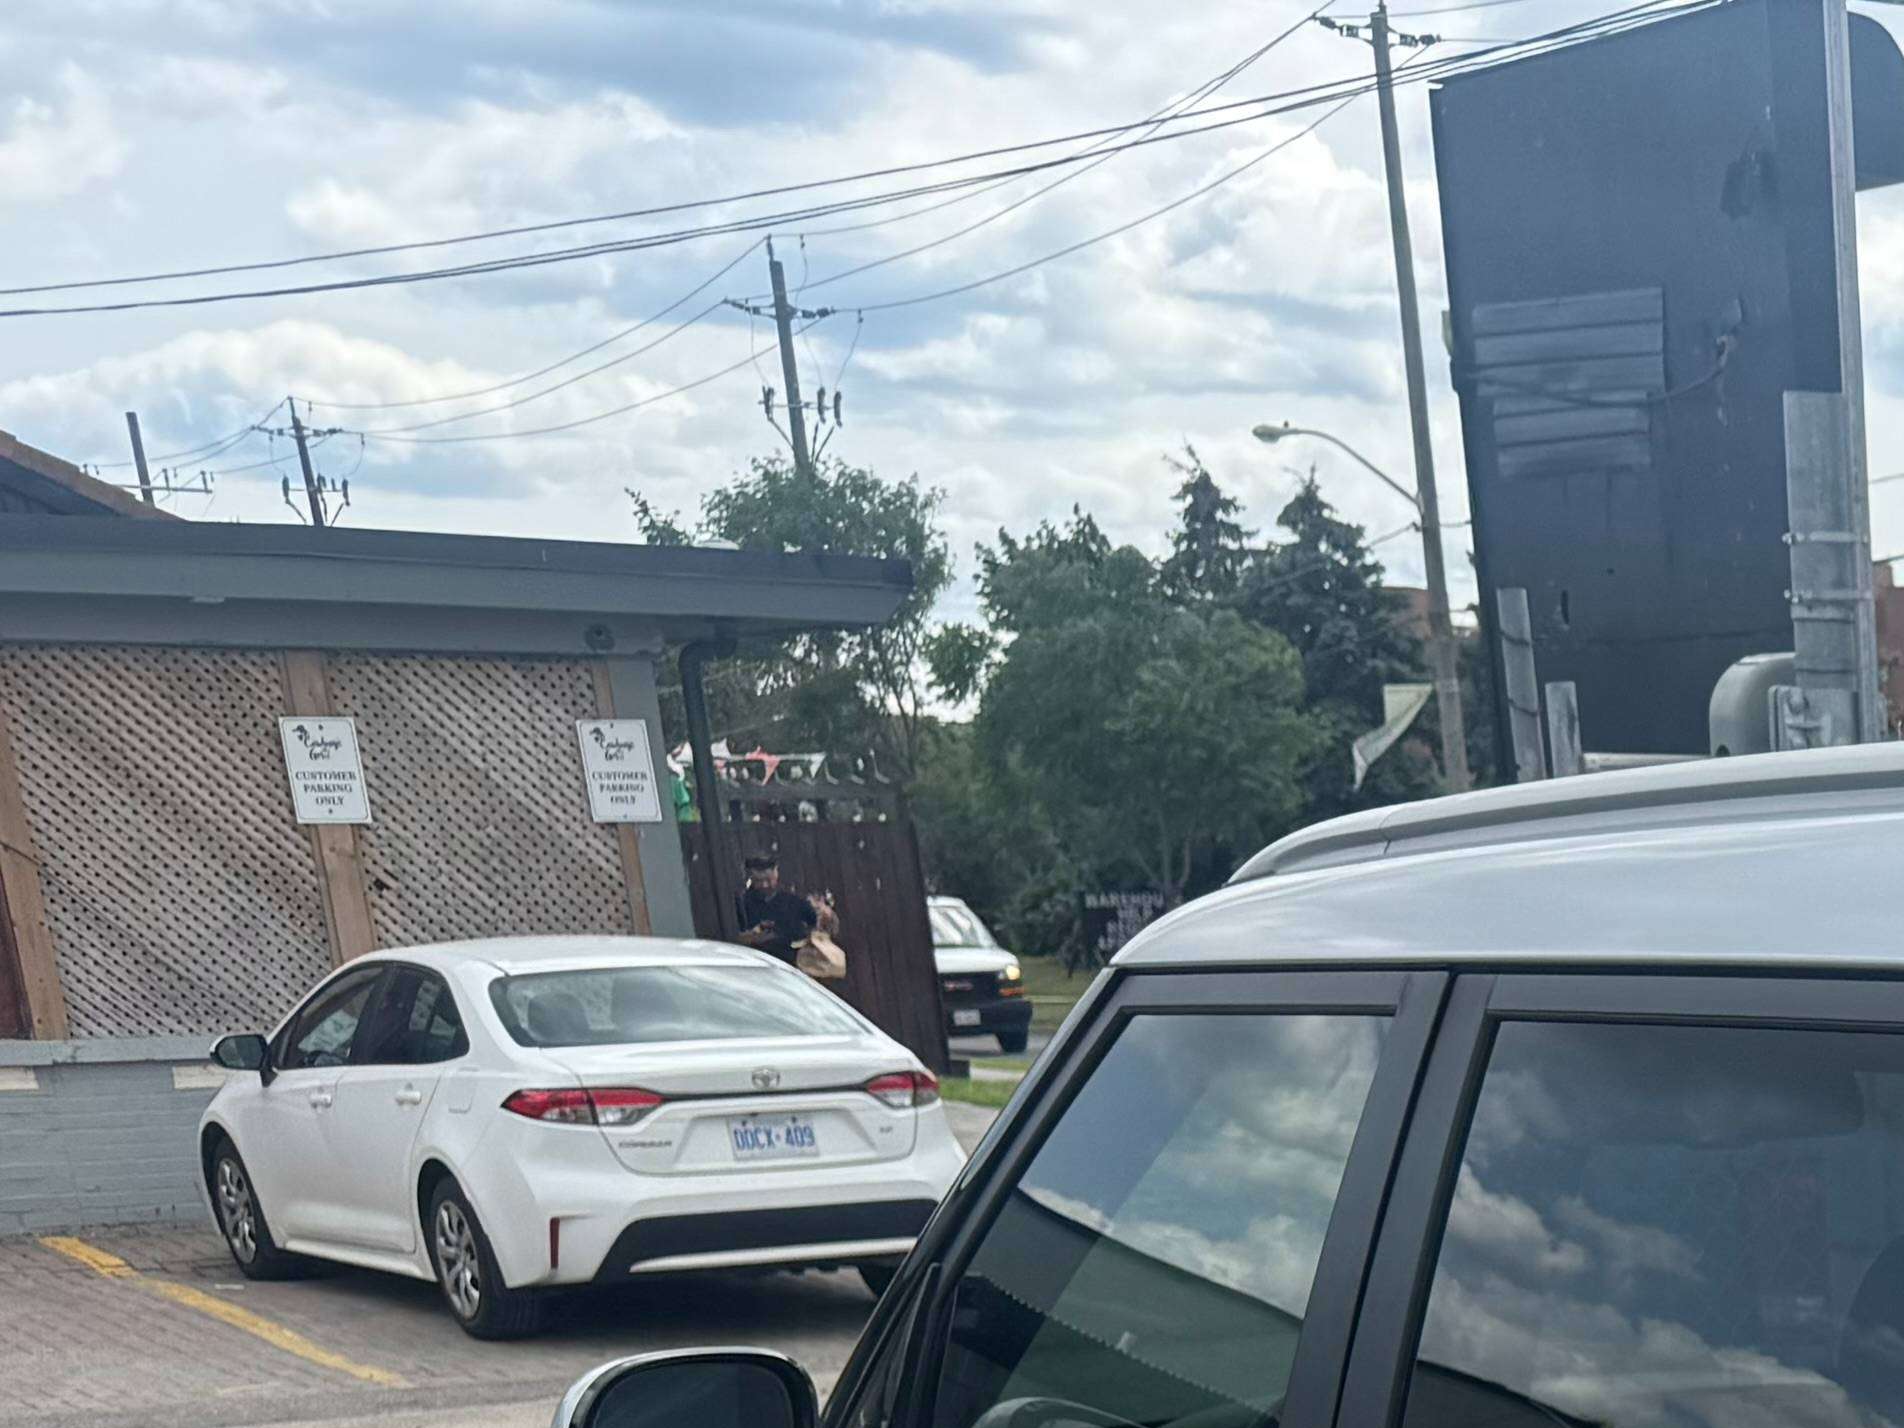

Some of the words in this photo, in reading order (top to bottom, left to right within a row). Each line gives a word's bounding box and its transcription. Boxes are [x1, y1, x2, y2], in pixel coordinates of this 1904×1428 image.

[295, 771, 357, 780] CUSTOMER
[592, 771, 648, 781] CUSTOMER
[303, 783, 353, 793] PARKING
[600, 783, 645, 793] PARKING
[315, 796, 344, 806] ONLY
[610, 796, 636, 805] ONLY
[786, 1125, 816, 1148] 409
